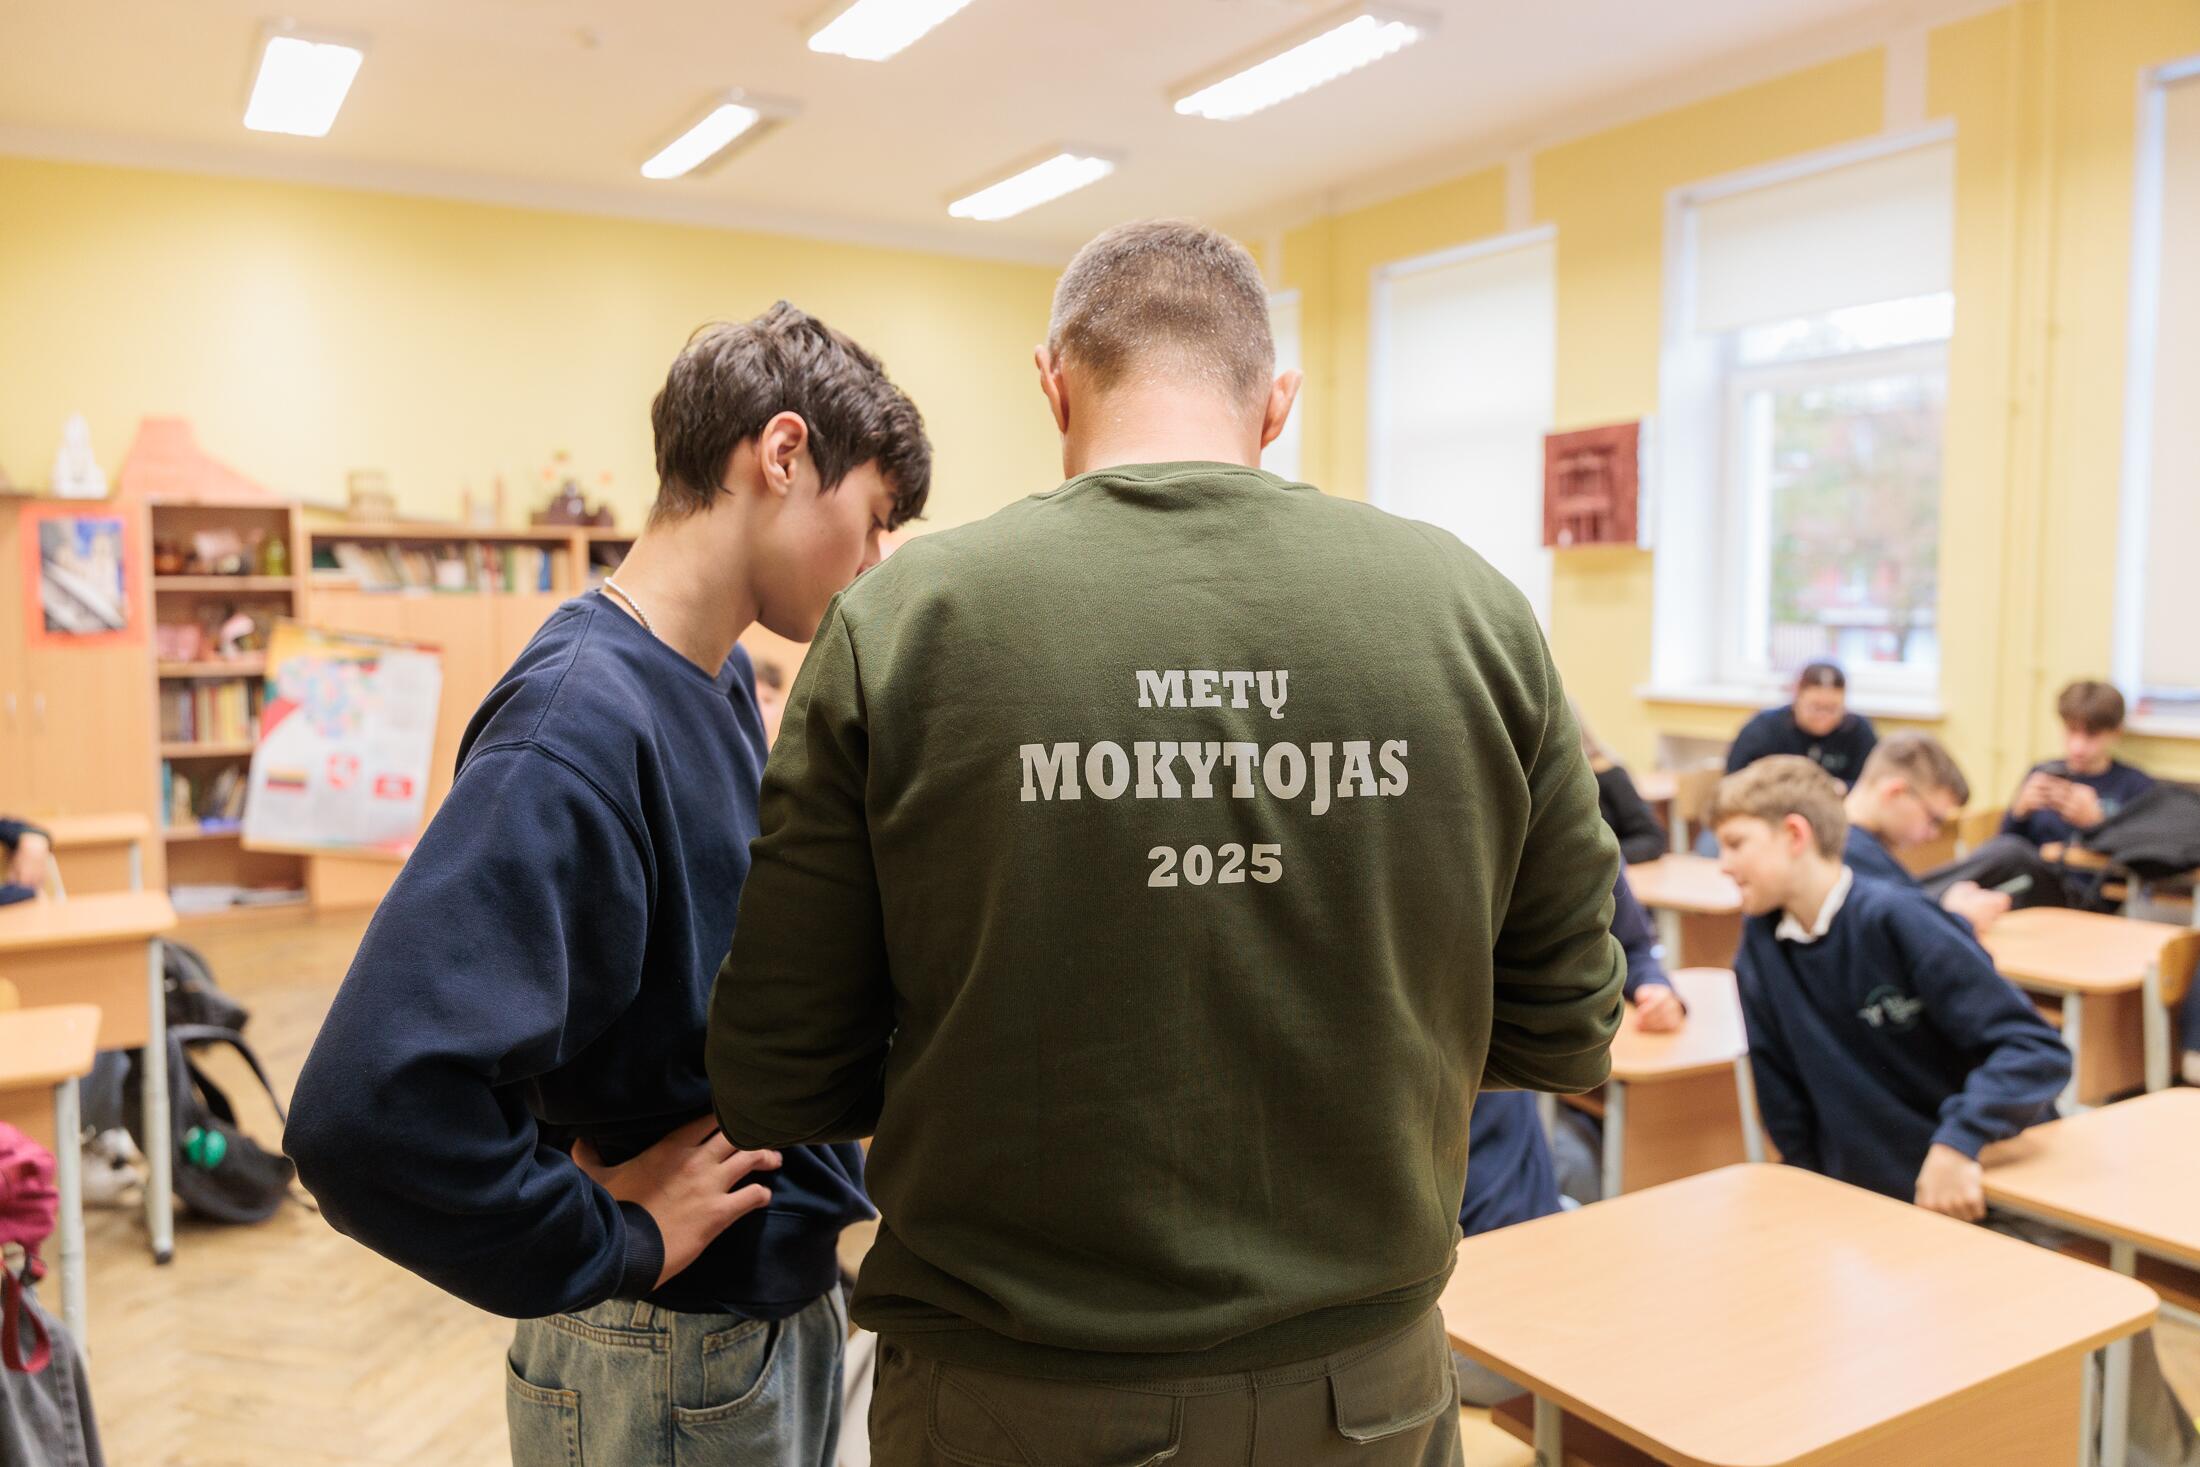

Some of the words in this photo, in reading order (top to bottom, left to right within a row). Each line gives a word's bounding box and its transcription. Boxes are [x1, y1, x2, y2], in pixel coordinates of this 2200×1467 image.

[1136, 669, 1289, 720] METŲ
[1019, 739, 1409, 816] MOKYTOJAS
[1147, 842, 1283, 888] 2025
